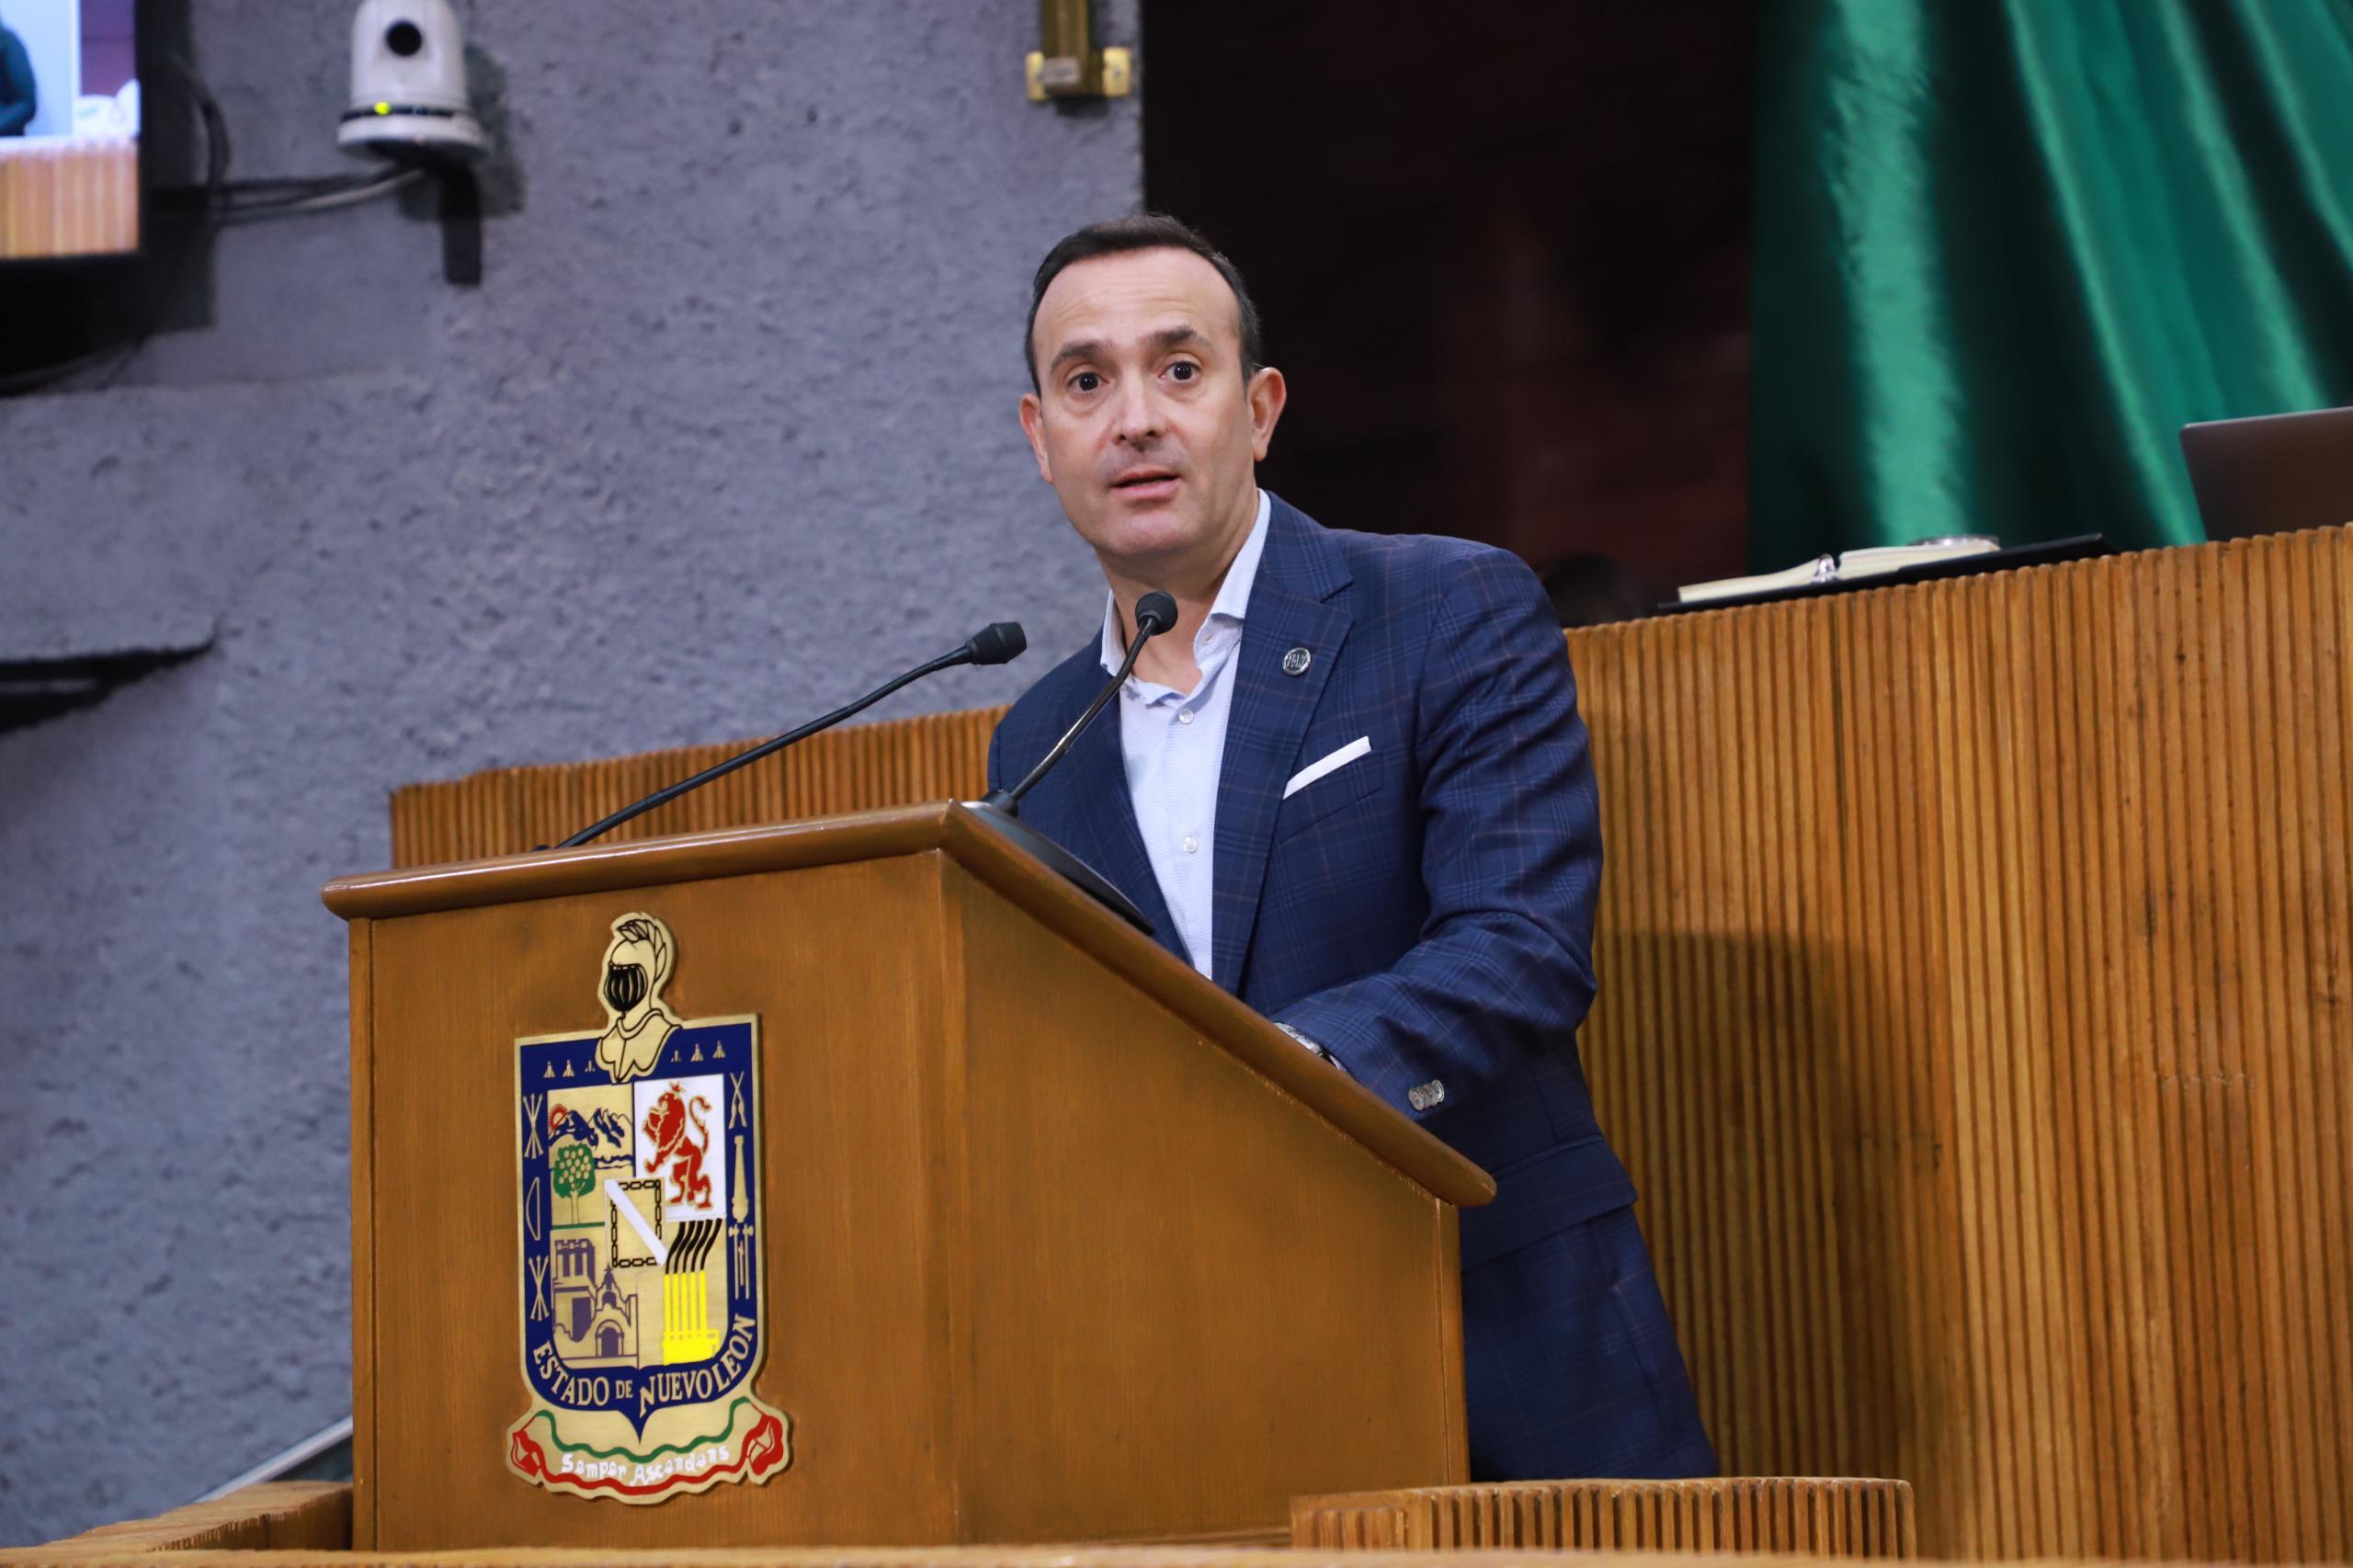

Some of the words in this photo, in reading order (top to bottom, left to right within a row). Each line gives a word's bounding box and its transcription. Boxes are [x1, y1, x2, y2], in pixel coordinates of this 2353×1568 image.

[533, 1340, 609, 1406] ESTADO
[615, 1380, 634, 1399] DE
[561, 1452, 627, 1480] Semper
